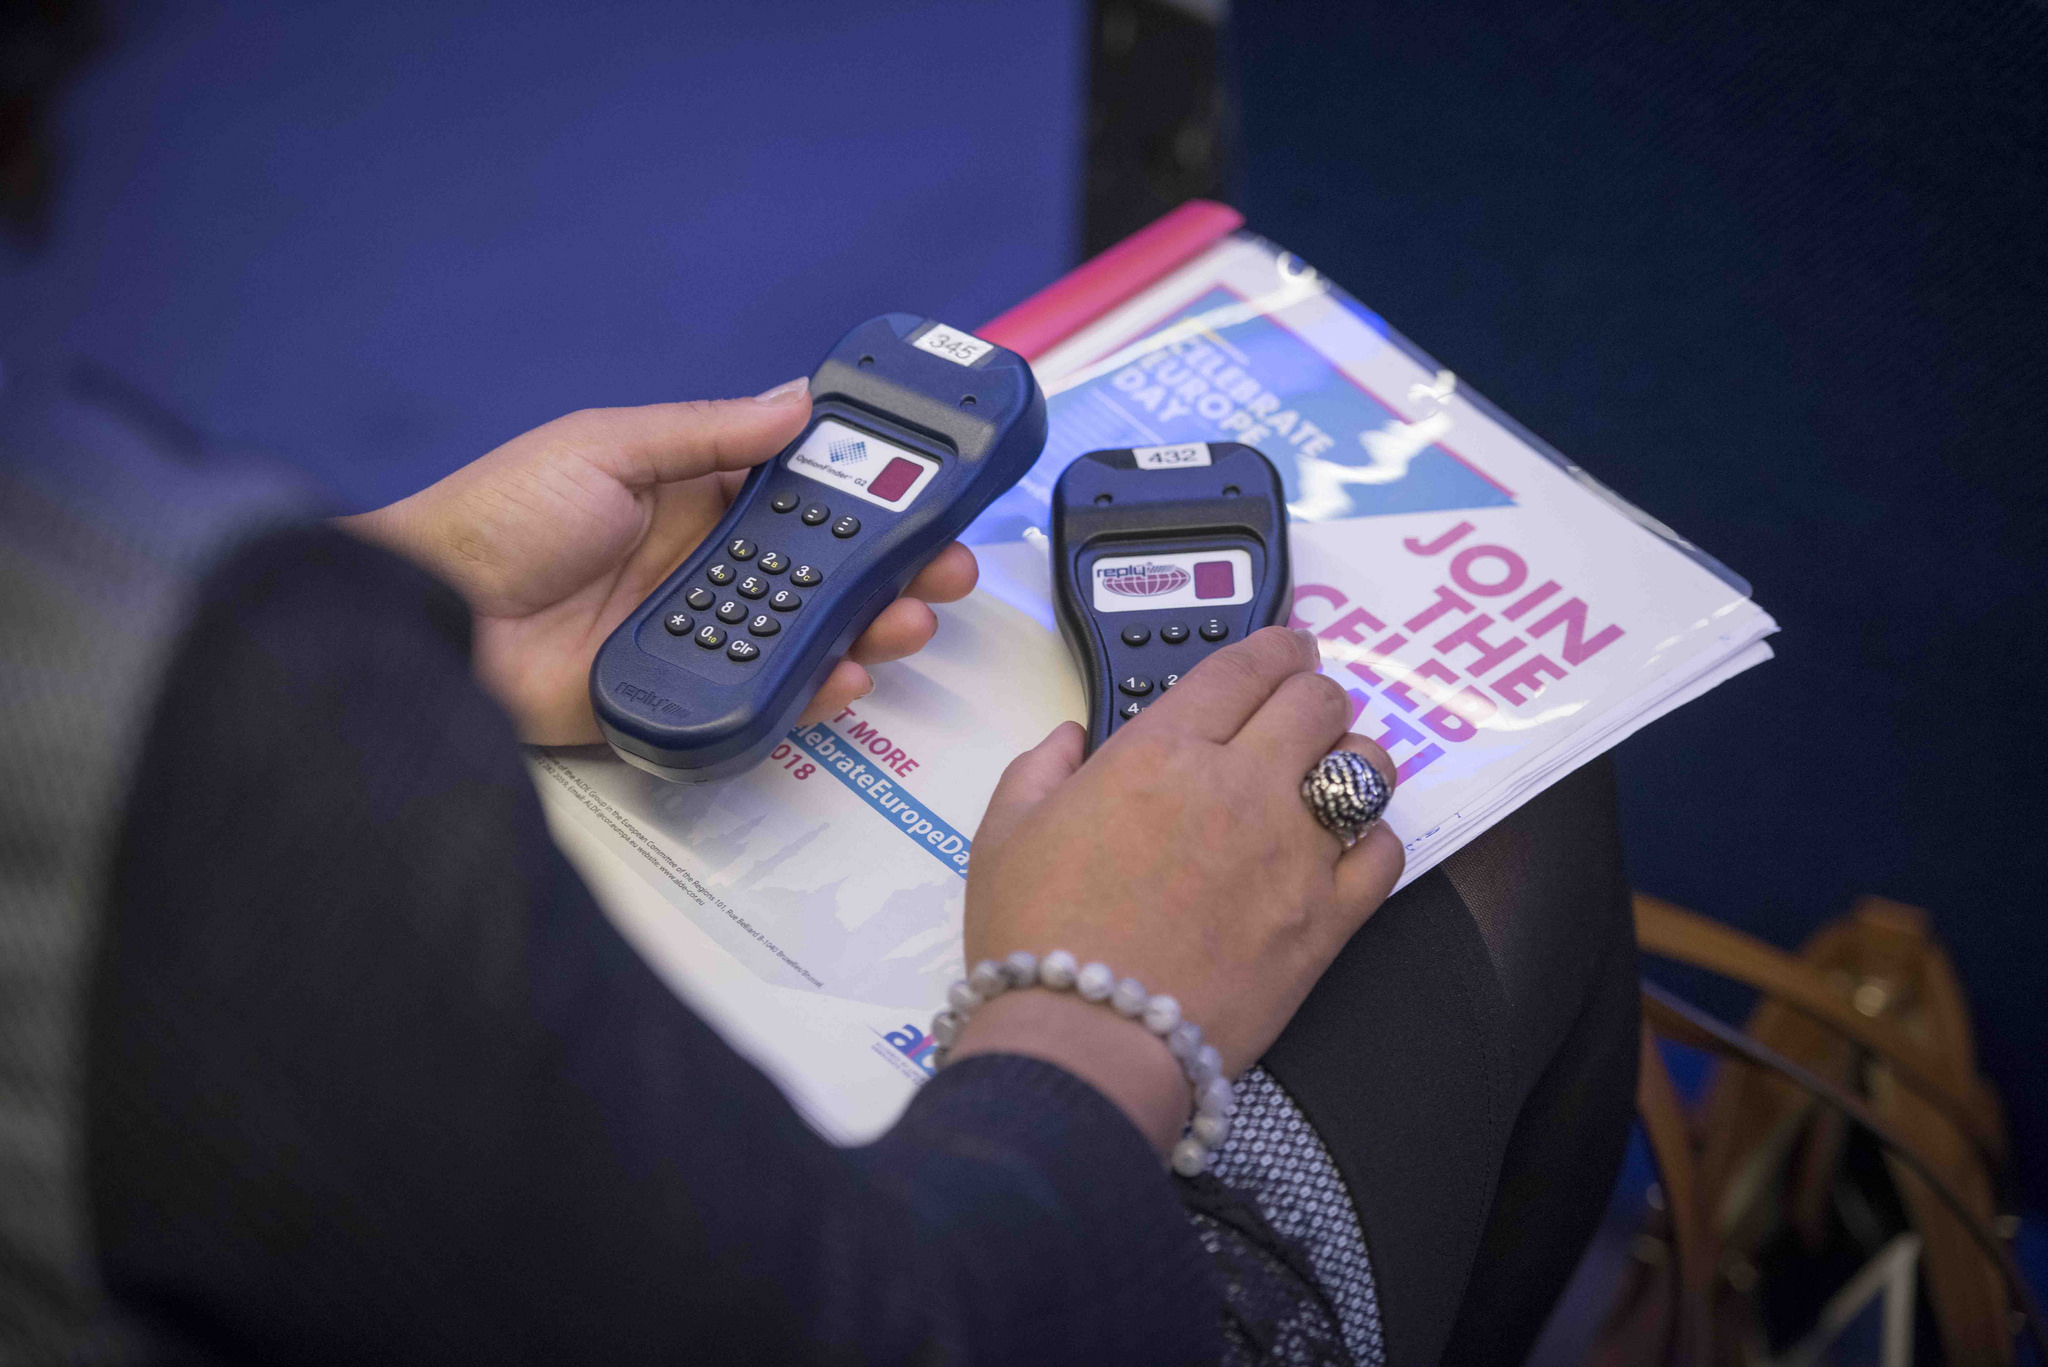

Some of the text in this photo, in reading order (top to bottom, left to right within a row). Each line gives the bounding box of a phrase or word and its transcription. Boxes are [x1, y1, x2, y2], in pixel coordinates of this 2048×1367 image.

[929, 334, 978, 359] 345
[1111, 366, 1194, 423] DAY
[1148, 448, 1198, 464] 432
[853, 478, 868, 487] G2
[1096, 565, 1146, 578] reply
[689, 588, 703, 599] 7
[775, 590, 789, 602] 6
[1403, 520, 1626, 667] JOIN
[721, 601, 735, 613] 8
[753, 615, 768, 627] 9
[731, 640, 754, 655] Clr
[1402, 584, 1570, 708] THE
[1126, 676, 1135, 688] 1
[1167, 674, 1179, 686] 2
[1127, 702, 1139, 714] 4
[847, 721, 920, 778] MORE
[770, 744, 817, 781] 018
[588, 790, 608, 808] Group
[611, 810, 623, 821] the
[620, 818, 648, 843] European
[646, 840, 678, 869] Committee
[675, 866, 687, 875] of
[682, 872, 694, 883] the
[692, 880, 716, 901] Regions
[725, 909, 739, 921] Rue
[736, 918, 761, 938] Belliard
